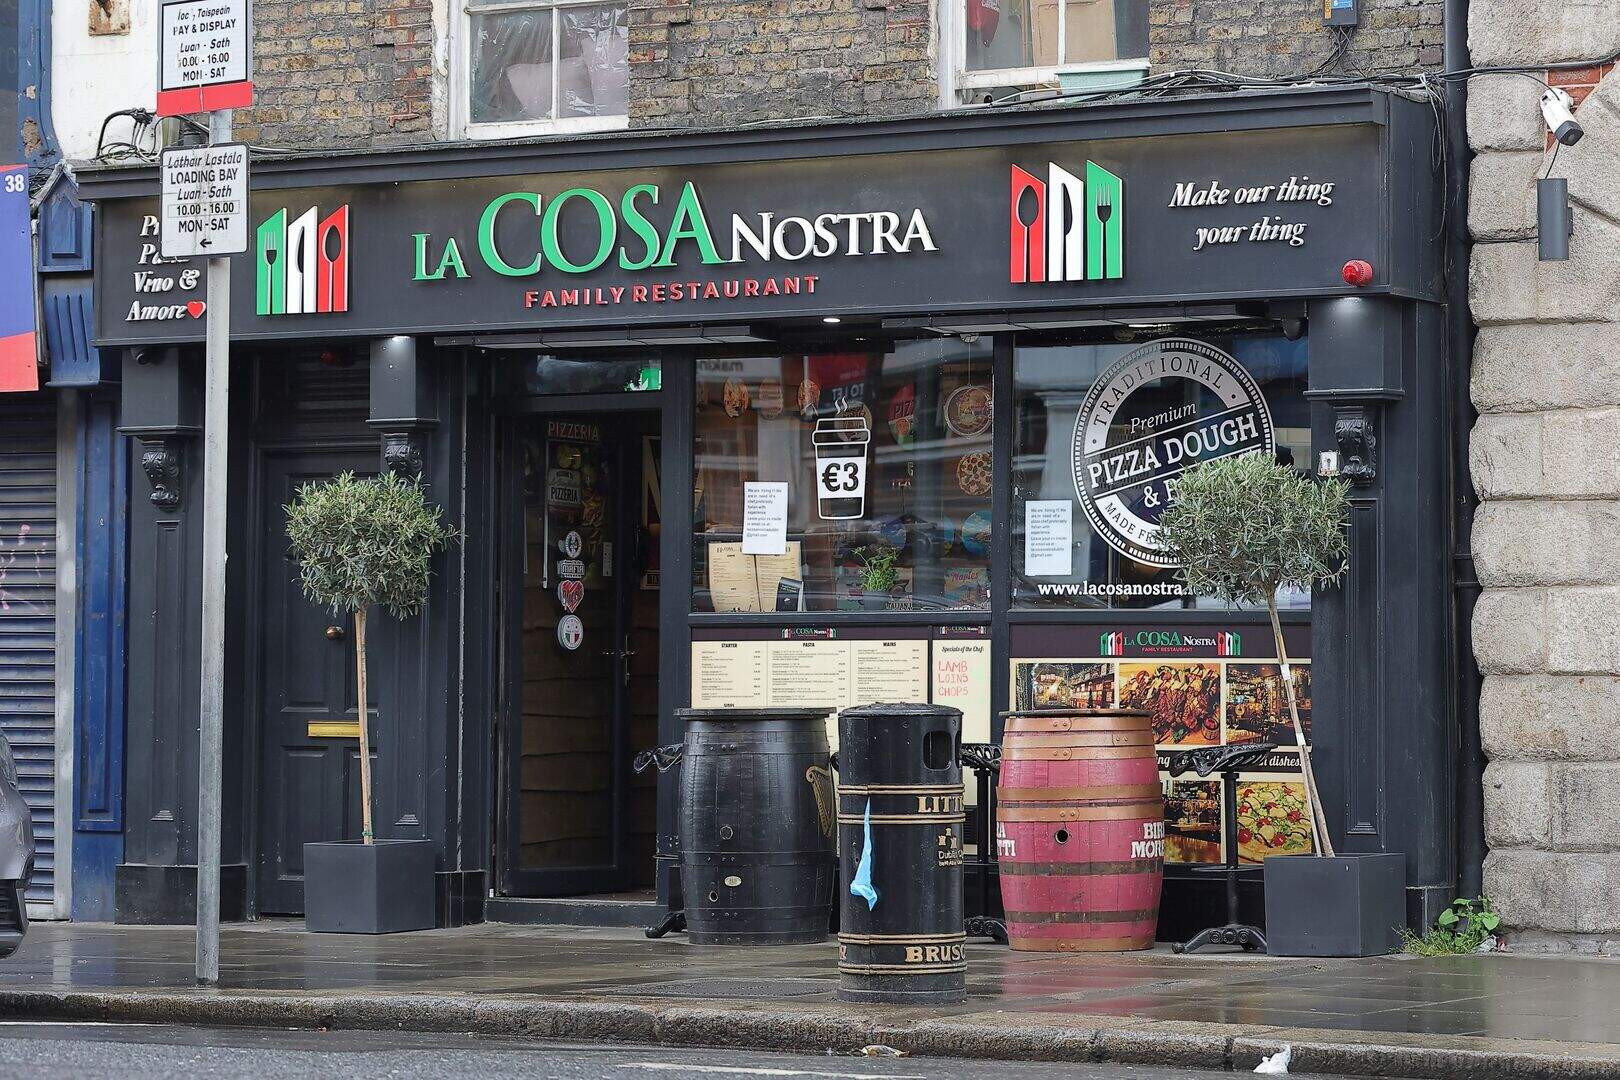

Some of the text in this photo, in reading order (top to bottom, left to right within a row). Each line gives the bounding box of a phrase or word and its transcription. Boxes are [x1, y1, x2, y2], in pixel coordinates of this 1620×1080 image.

[192, 24, 197, 34] &
[200, 19, 236, 32] DISPLAY
[180, 42, 200, 53] Luan
[210, 37, 230, 50] Sath
[207, 52, 230, 64] 16.00
[210, 67, 226, 78] SAT
[5, 174, 24, 192] 38
[171, 168, 238, 184] LOADING BAY
[178, 188, 200, 200] Luan
[208, 185, 232, 198] Sath
[1168, 176, 1335, 208] Make our thing
[177, 204, 200, 216] 10.00
[210, 202, 234, 214] 16.00
[178, 220, 202, 232] MON
[211, 218, 230, 230] SAT
[477, 181, 731, 277] COSA
[1193, 216, 1307, 250] your thing
[134, 270, 200, 292] Vino &
[525, 276, 819, 308] FAMILY RESTAURANT
[125, 300, 187, 321] Amore
[1094, 356, 1224, 428] TRADITIONAL
[1130, 403, 1196, 434] Premium
[548, 422, 600, 440] PIZZERIA
[1088, 412, 1259, 489] PIZZA DOUGH
[822, 462, 859, 492] €3
[1144, 486, 1160, 508] &
[1104, 502, 1135, 534] MADE
[1136, 632, 1180, 646] COSA
[938, 660, 968, 673] LAMB
[938, 674, 969, 683] LOINS
[938, 686, 969, 697] CHOPS
